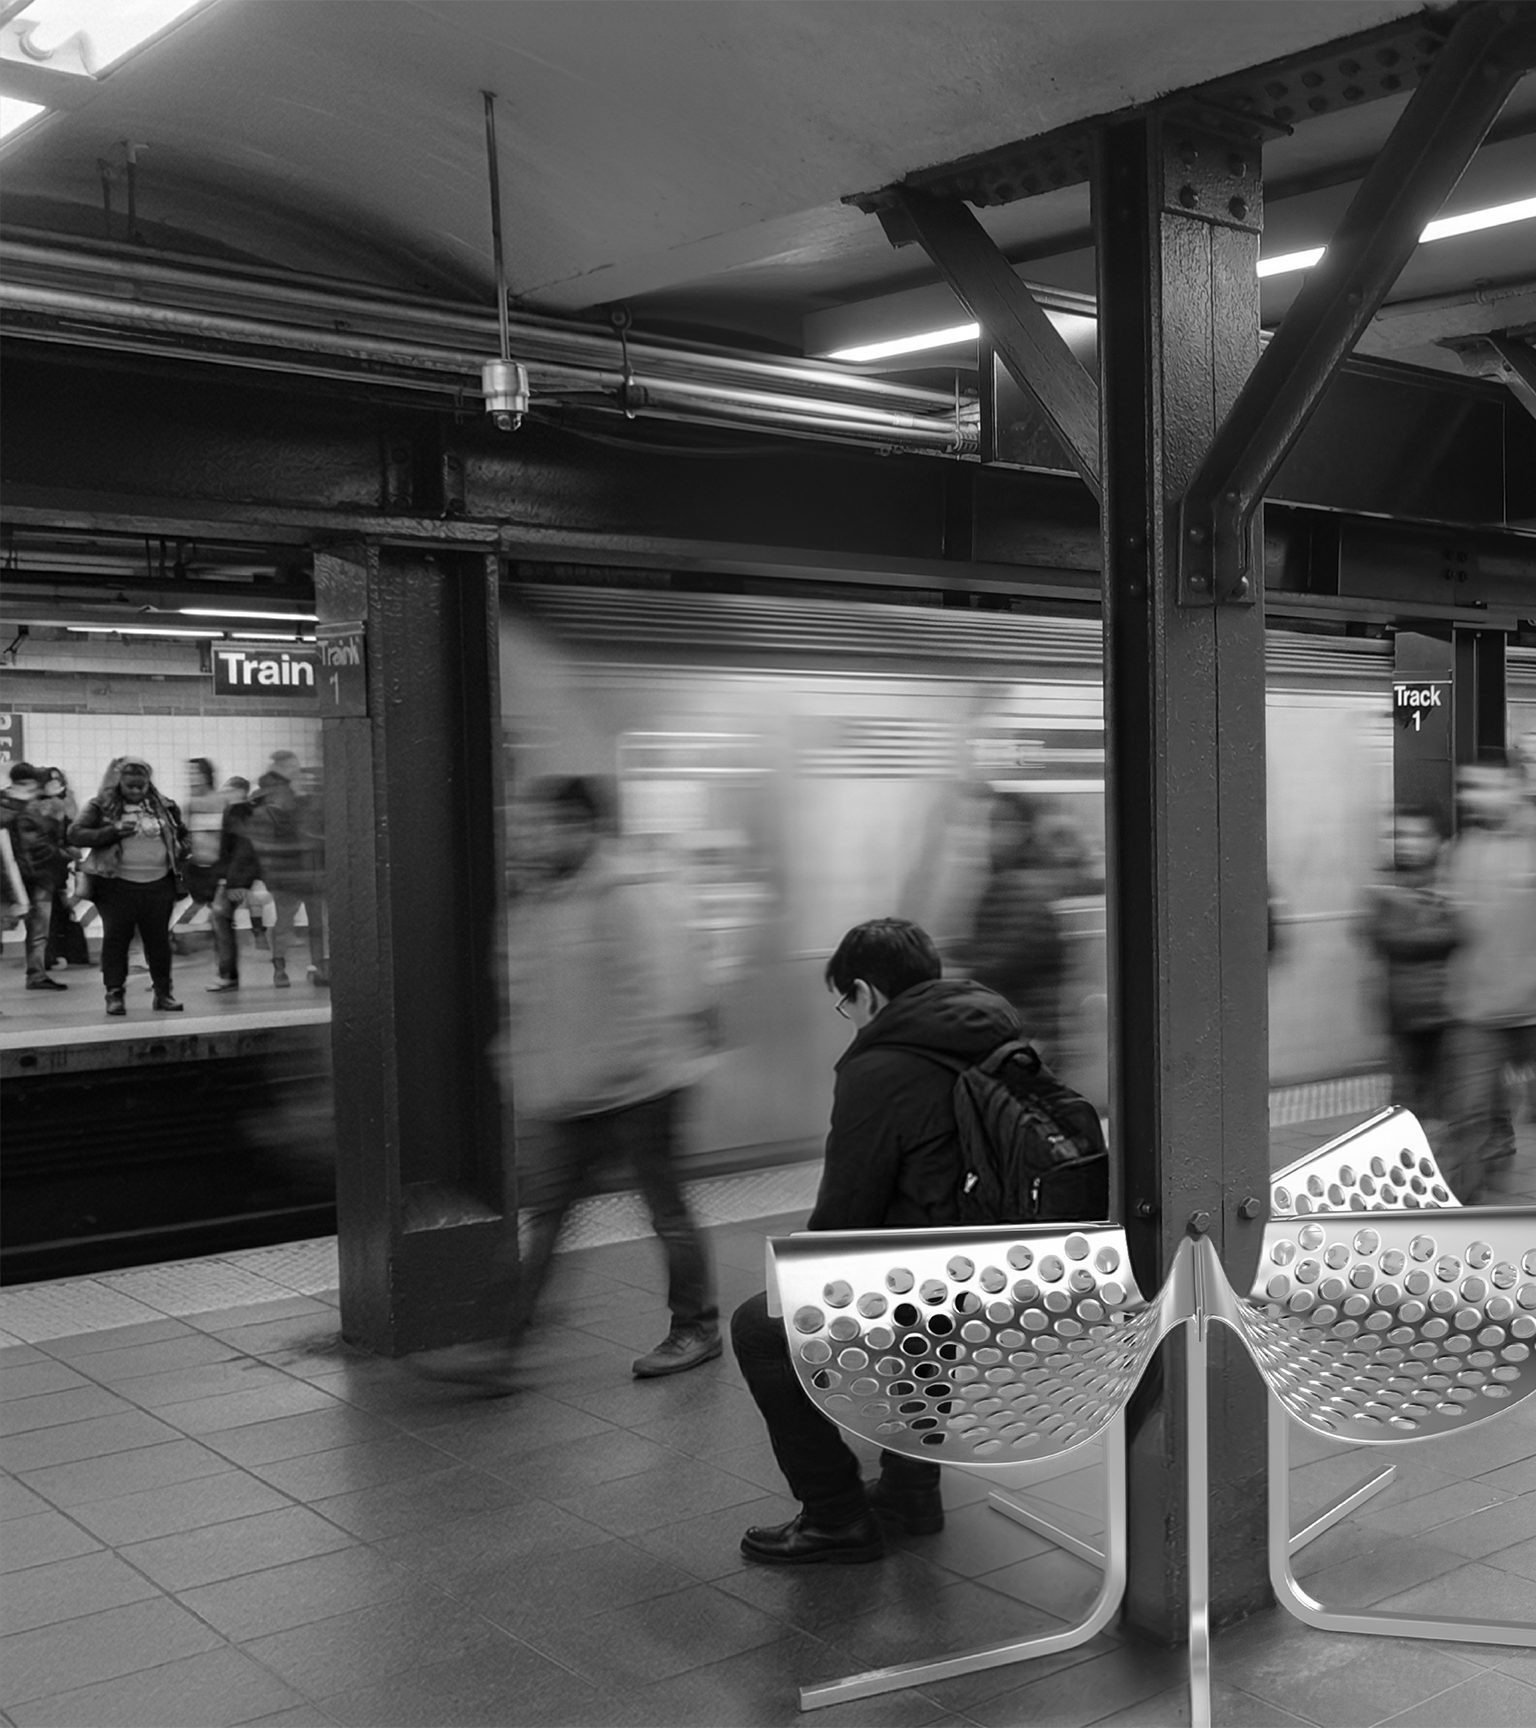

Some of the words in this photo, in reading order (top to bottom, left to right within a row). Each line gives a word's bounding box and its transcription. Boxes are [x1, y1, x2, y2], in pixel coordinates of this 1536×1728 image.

[218, 652, 314, 686] Train
[1394, 685, 1441, 707] Track
[1412, 710, 1420, 731] 1
